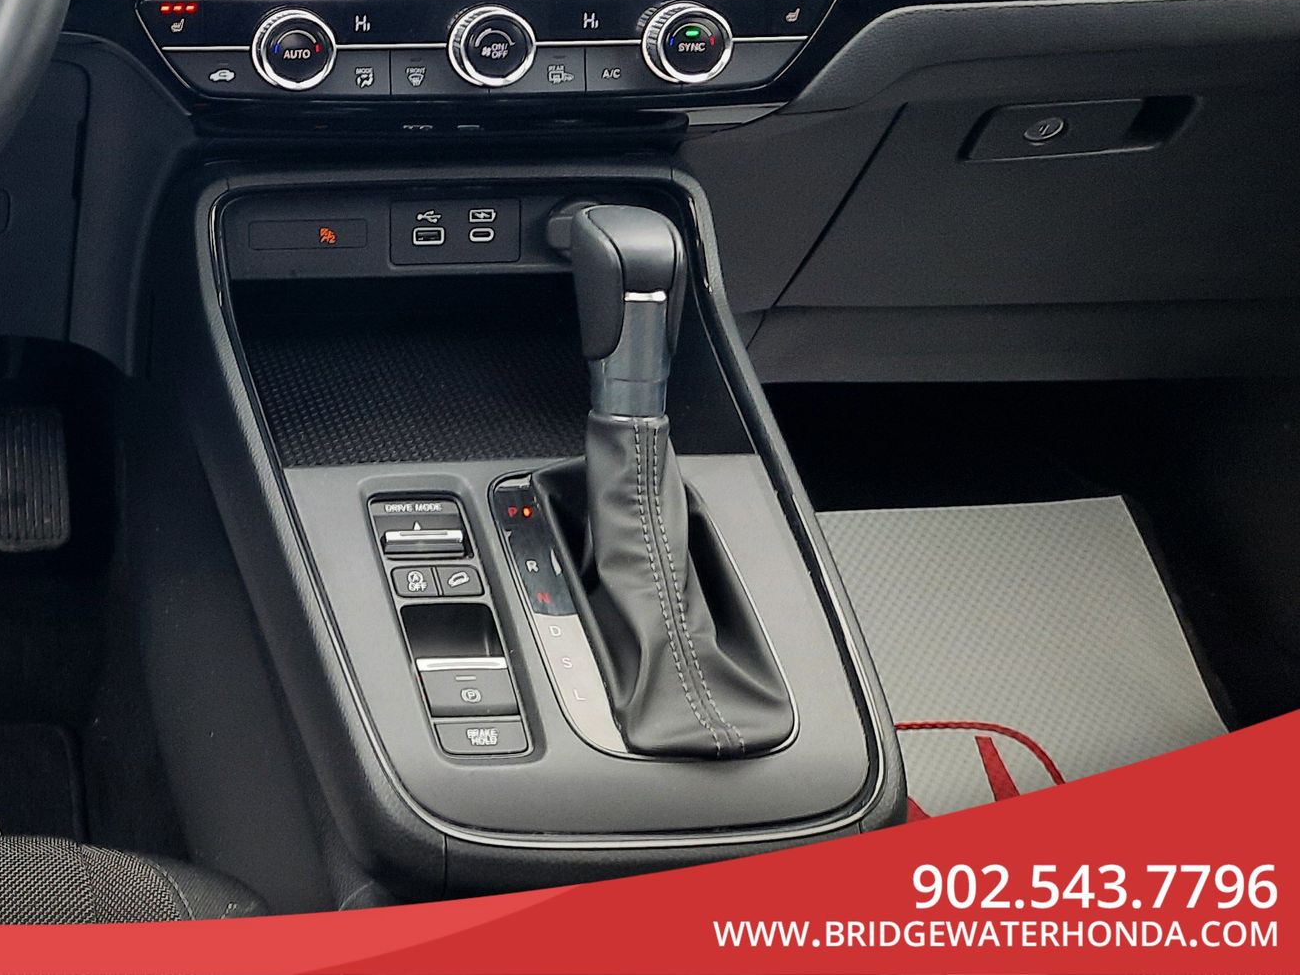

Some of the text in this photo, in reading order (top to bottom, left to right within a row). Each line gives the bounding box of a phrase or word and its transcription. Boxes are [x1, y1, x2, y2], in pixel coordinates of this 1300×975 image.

[678, 42, 706, 53] SYNC
[283, 49, 311, 60] AUTO
[492, 50, 508, 59] OFF
[406, 67, 426, 75] FRONT
[602, 68, 621, 79] A/C
[384, 503, 442, 513] DRIVE MODE
[507, 506, 517, 517] P
[526, 560, 539, 572] R
[408, 581, 427, 591] OFF
[537, 592, 551, 604] N
[550, 625, 562, 637] D
[562, 657, 573, 669] S
[573, 689, 587, 701] L
[467, 728, 498, 739] BRAKE
[470, 735, 498, 745] HOLD
